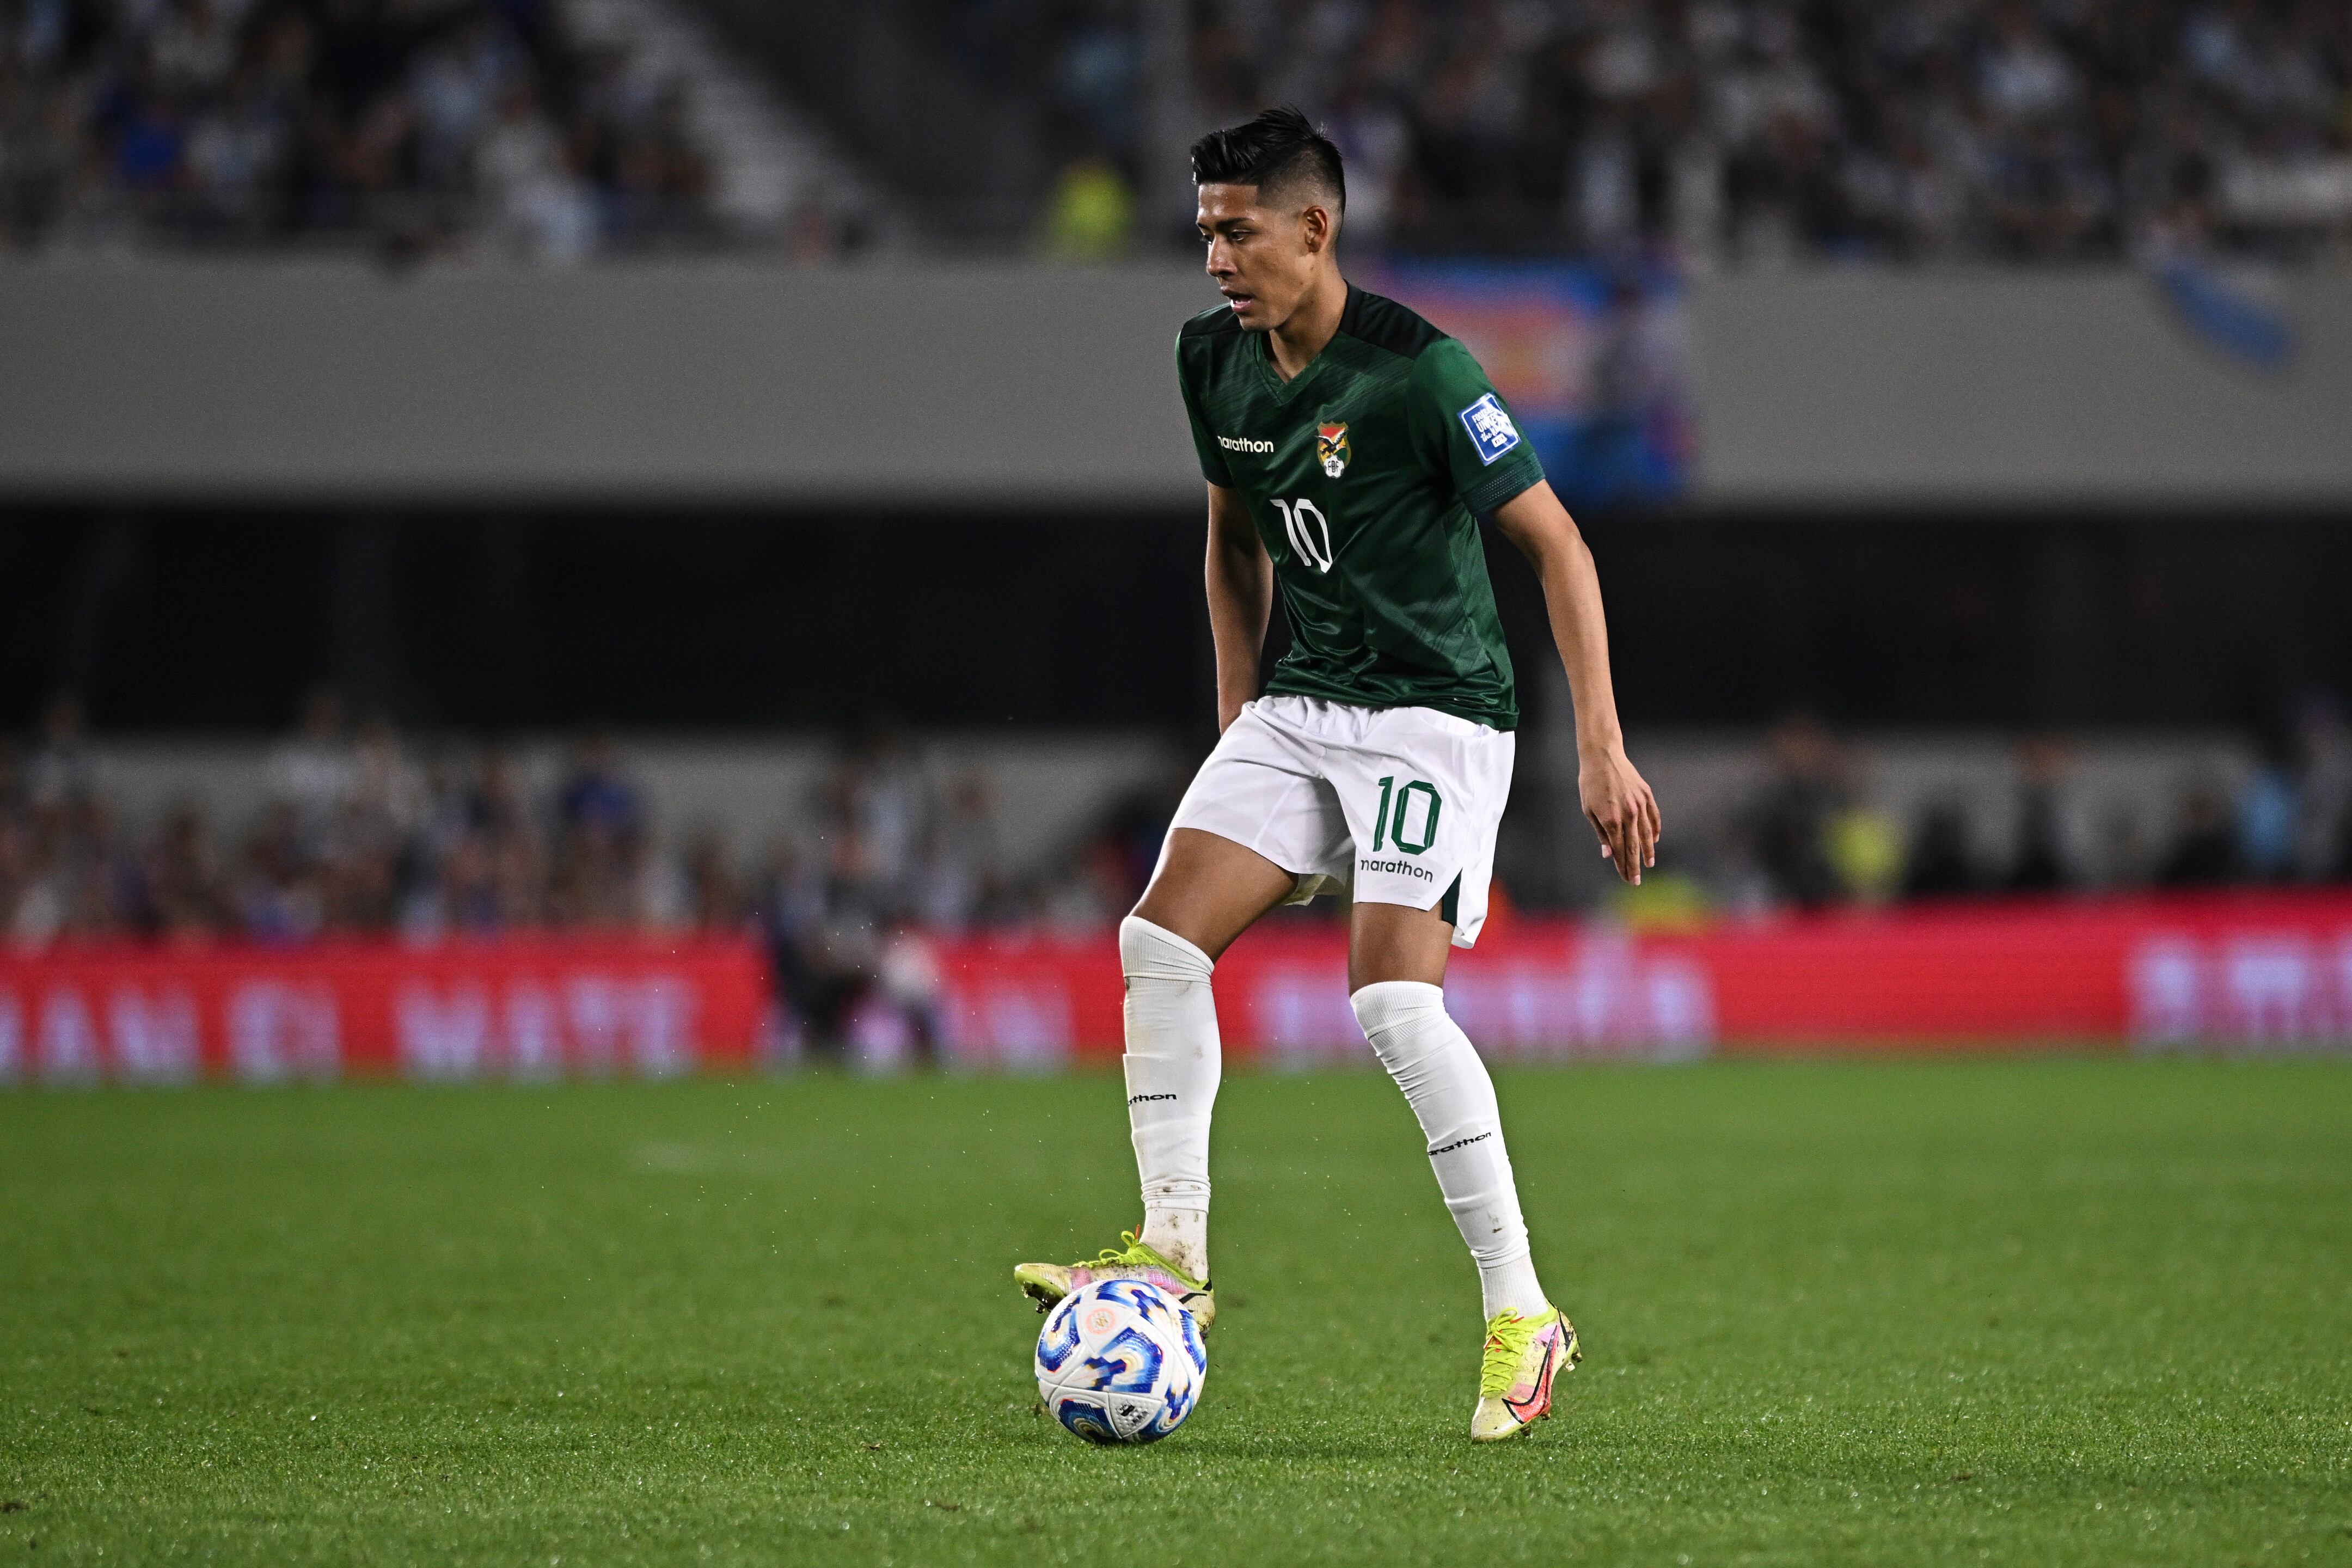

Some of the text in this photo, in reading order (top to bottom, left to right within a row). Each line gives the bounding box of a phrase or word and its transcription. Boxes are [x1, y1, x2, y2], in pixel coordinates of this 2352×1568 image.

[1270, 499, 1332, 573] 10
[1373, 776, 1442, 855] 10
[1428, 1132, 1491, 1155] arathon
